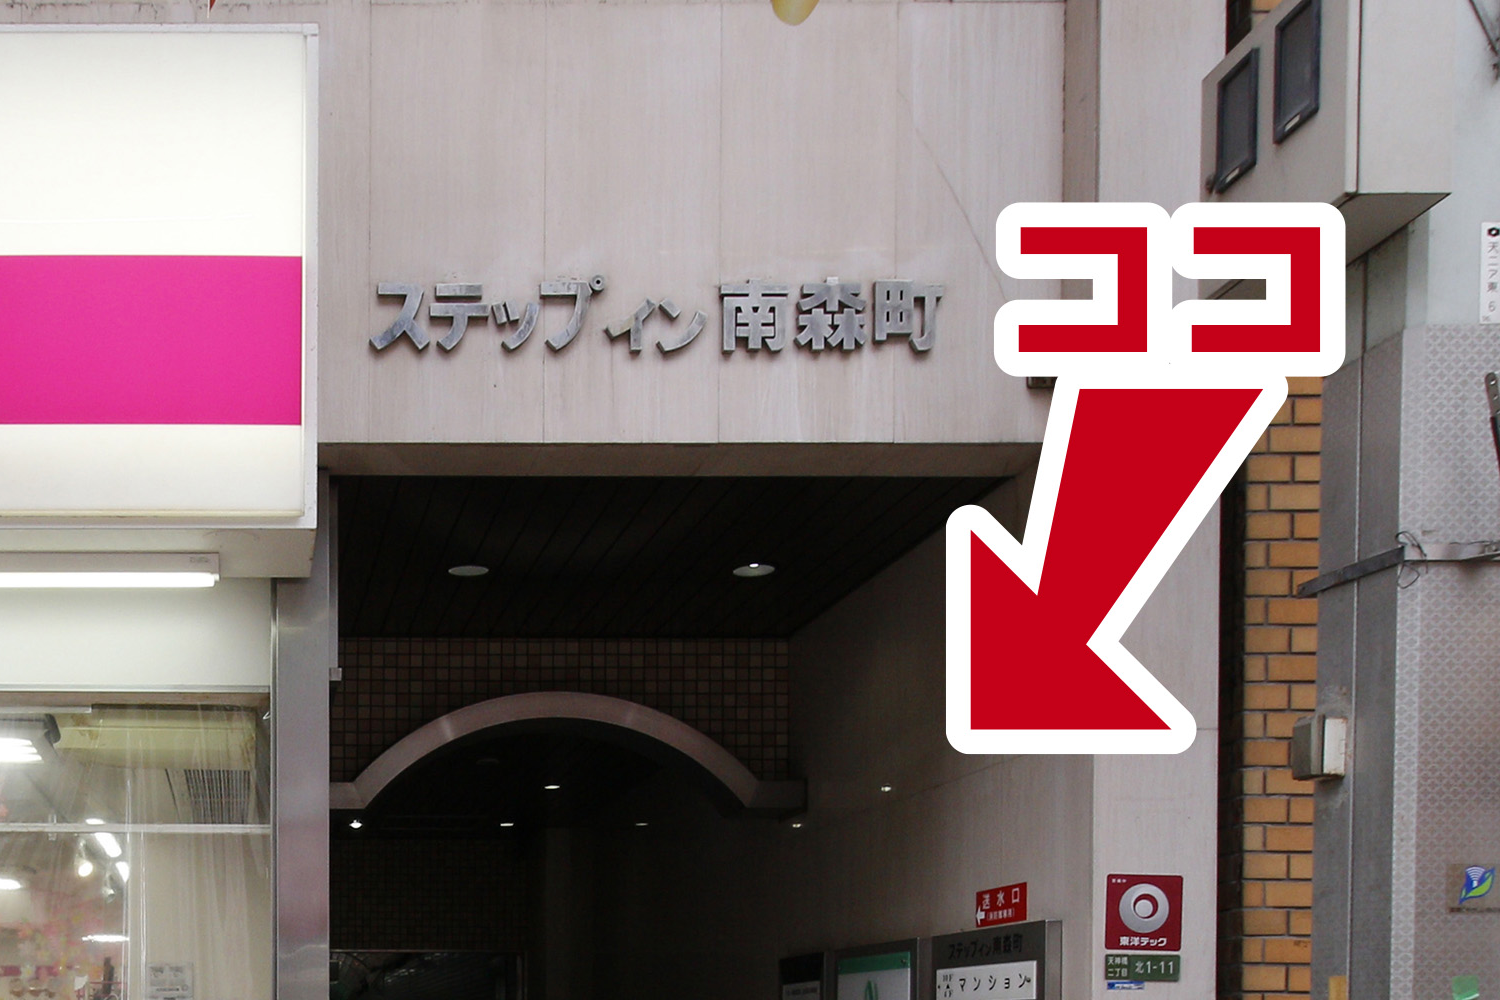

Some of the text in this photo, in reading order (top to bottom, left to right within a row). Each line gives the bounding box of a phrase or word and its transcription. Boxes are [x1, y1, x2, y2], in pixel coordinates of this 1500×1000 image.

[981, 887, 1021, 909] 送水口
[1119, 936, 1168, 947] 東洋テック
[1107, 967, 1128, 977] 二丁目
[958, 973, 1027, 992] マンション
